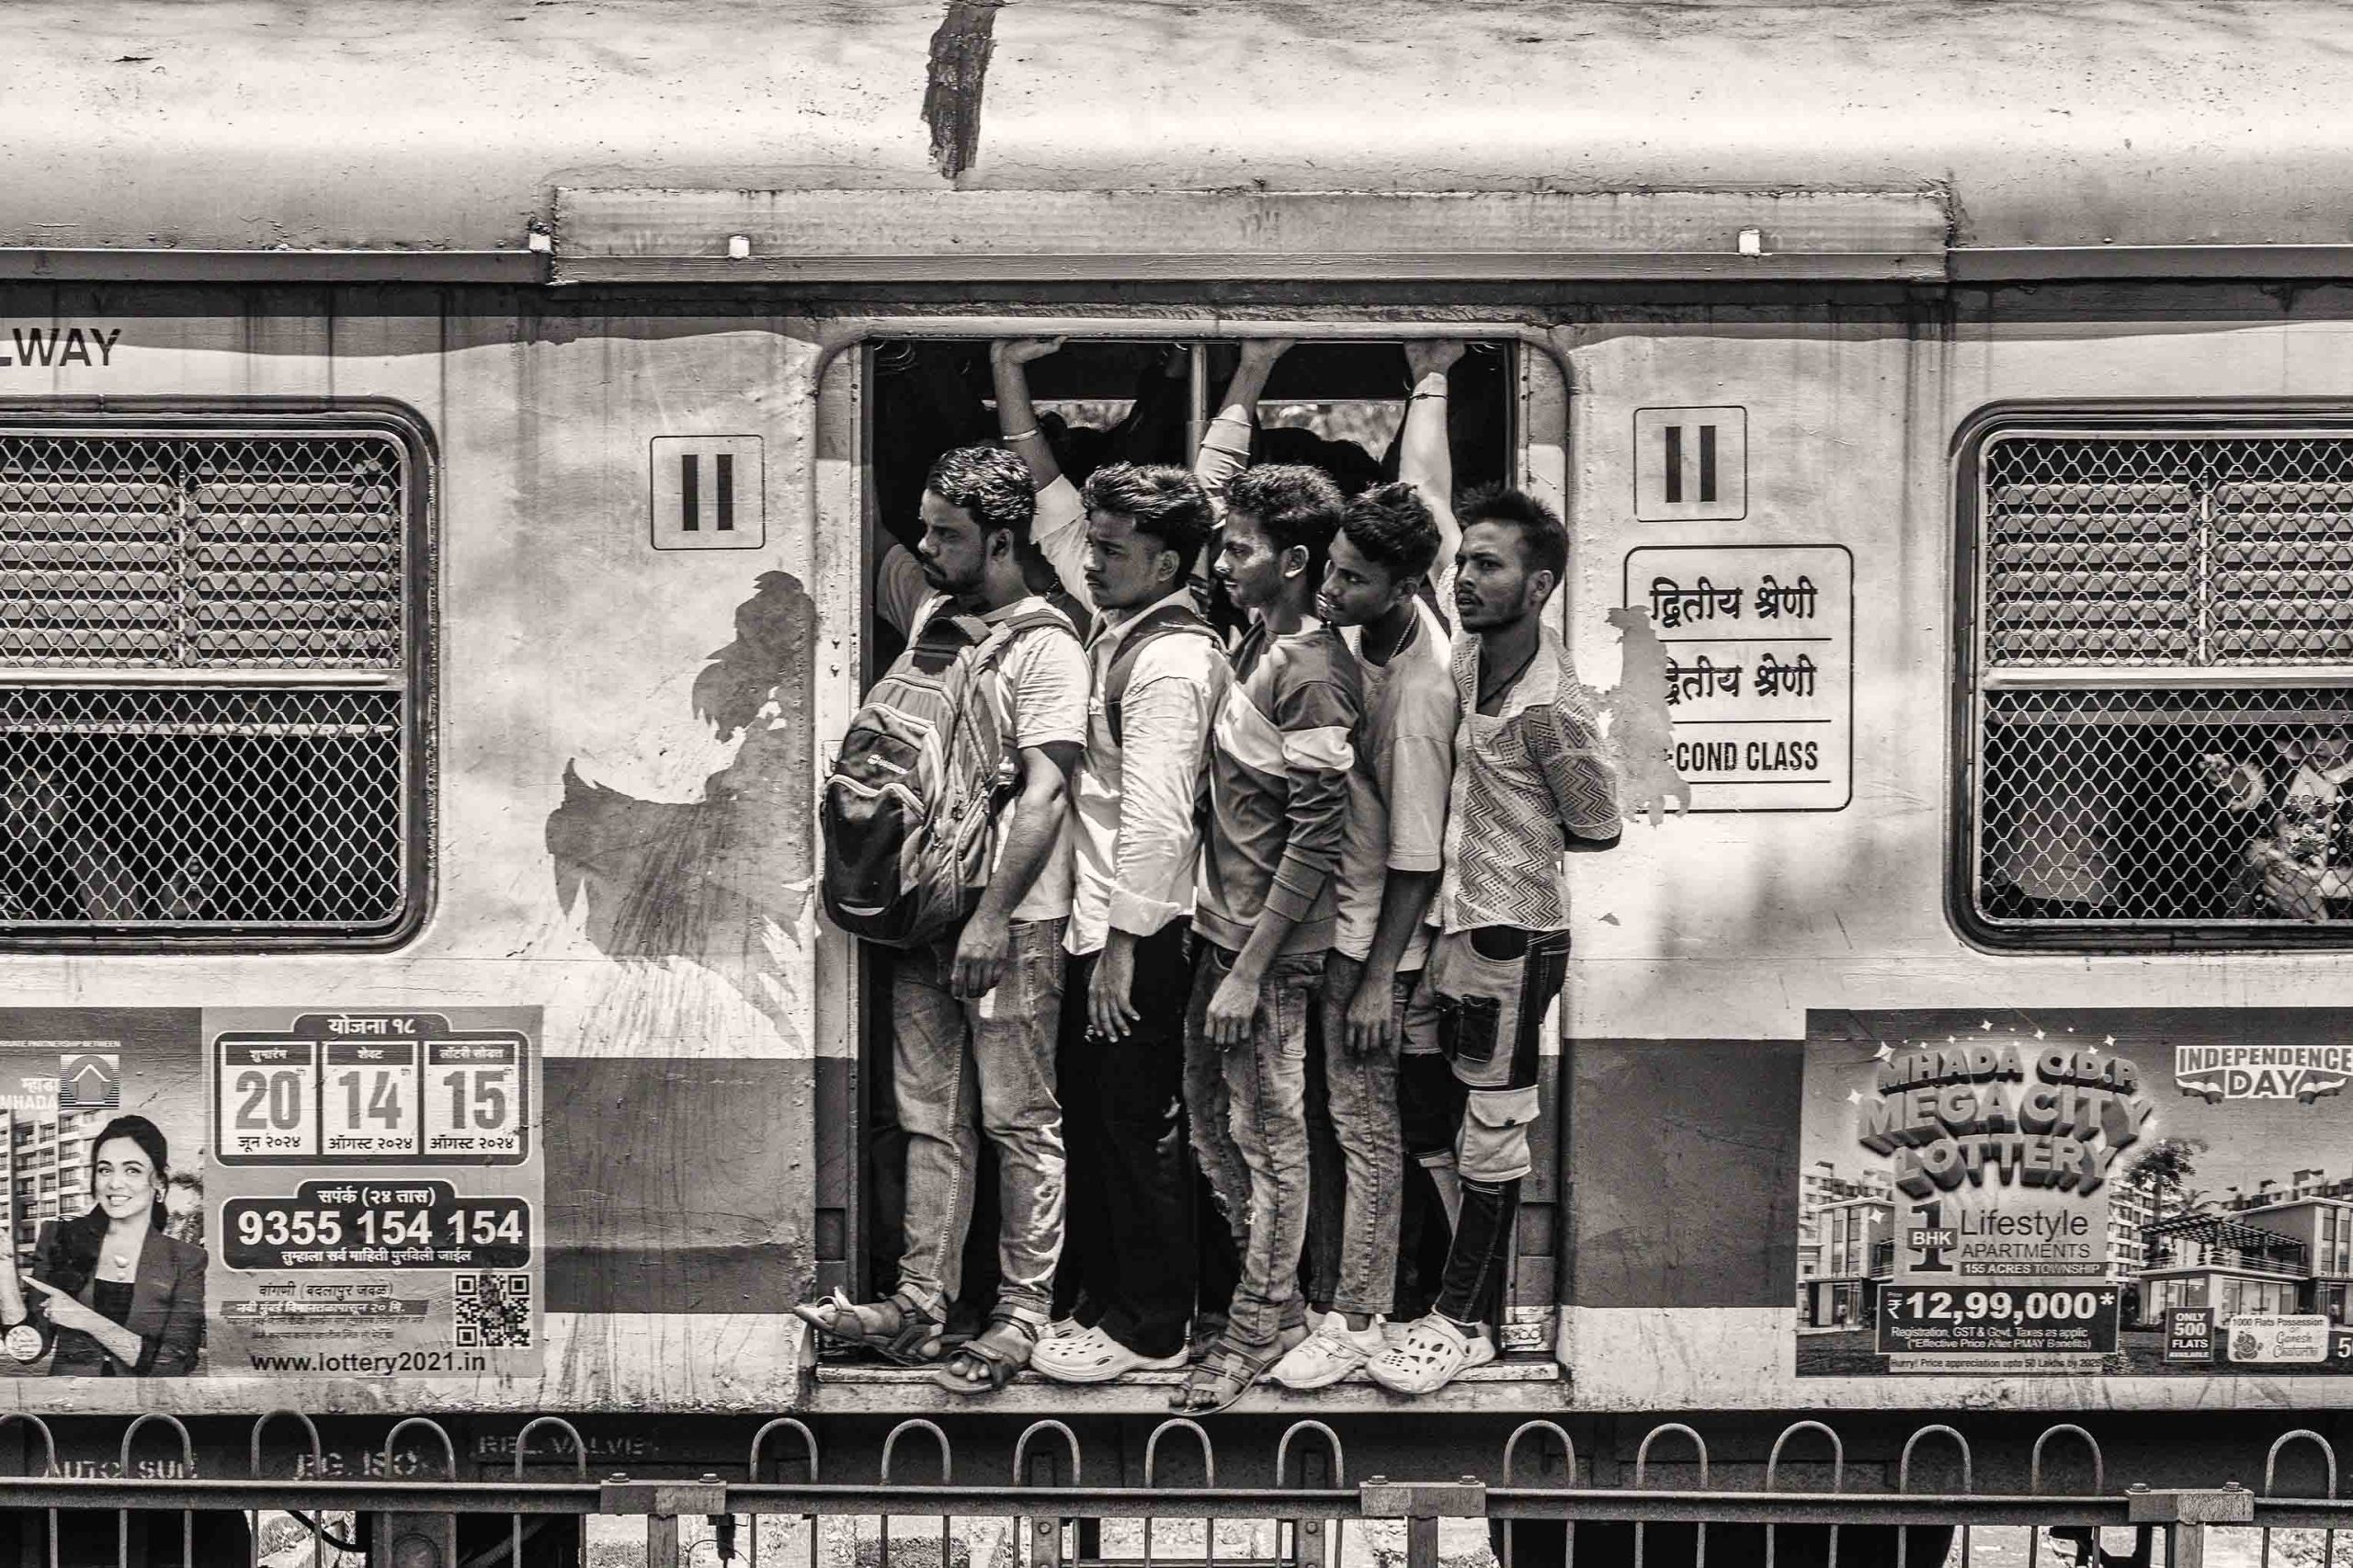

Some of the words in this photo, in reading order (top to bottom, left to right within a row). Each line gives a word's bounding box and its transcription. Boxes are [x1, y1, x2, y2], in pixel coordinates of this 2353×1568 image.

[1649, 576, 1744, 629] द्वितीय
[1754, 574, 1818, 619] श्रेणी
[1754, 653, 1818, 697] श्रेणी
[1665, 742, 1738, 771] COND
[1746, 741, 1819, 771] CLASS
[326, 1015, 388, 1035] योजना
[392, 1017, 416, 1034] १८
[1878, 1045, 2025, 1094] MHADA
[2179, 1048, 2353, 1073] INDEPENDENCE
[2228, 1070, 2299, 1096] DAY
[234, 1071, 301, 1131] 20
[338, 1071, 403, 1130] 14
[443, 1071, 506, 1131] 15
[1859, 1081, 2018, 1154] MEGA
[2019, 1083, 2154, 1149] CITY
[237, 1136, 261, 1153] जून
[265, 1136, 301, 1148] २०२४
[329, 1134, 372, 1150] ऑगस्ट
[377, 1137, 413, 1149] २०२४
[431, 1134, 475, 1150] ऑगस्ट
[478, 1137, 514, 1149] २०२४
[1893, 1131, 2119, 1197] LOTTERY
[395, 1187, 436, 1207] तास)
[237, 1210, 342, 1245] 9355
[356, 1210, 433, 1245] 154
[447, 1210, 523, 1244] 154
[1961, 1210, 2089, 1242] Lifestyle
[1912, 1231, 1953, 1245] BHK
[280, 1249, 324, 1266] तुम्हाला
[327, 1247, 347, 1262] सर्व
[349, 1247, 389, 1262] माहिती
[392, 1246, 434, 1265] पुरविली
[437, 1248, 472, 1263] जाईल
[1961, 1244, 2091, 1258] APARTMENTS
[1964, 1264, 1985, 1274] 155
[1988, 1264, 2031, 1274] ACRES
[2034, 1264, 2101, 1274] TOWNSHIP
[2176, 1312, 2206, 1322] ONLY
[2255, 1318, 2275, 1326] Flats
[2277, 1318, 2324, 1326] Possession
[1953, 1327, 1977, 1337] GST
[1978, 1327, 1985, 1337] &
[2016, 1327, 2043, 1337] Taxes
[2174, 1323, 2206, 1336] 500
[1961, 1339, 1985, 1348] Price
[1987, 1339, 2013, 1348] After
[2172, 1339, 2209, 1348] FLATS
[2337, 1337, 2353, 1358] 5
[250, 1352, 486, 1376] www.lottery2021.in
[1920, 1359, 1943, 1368] Price
